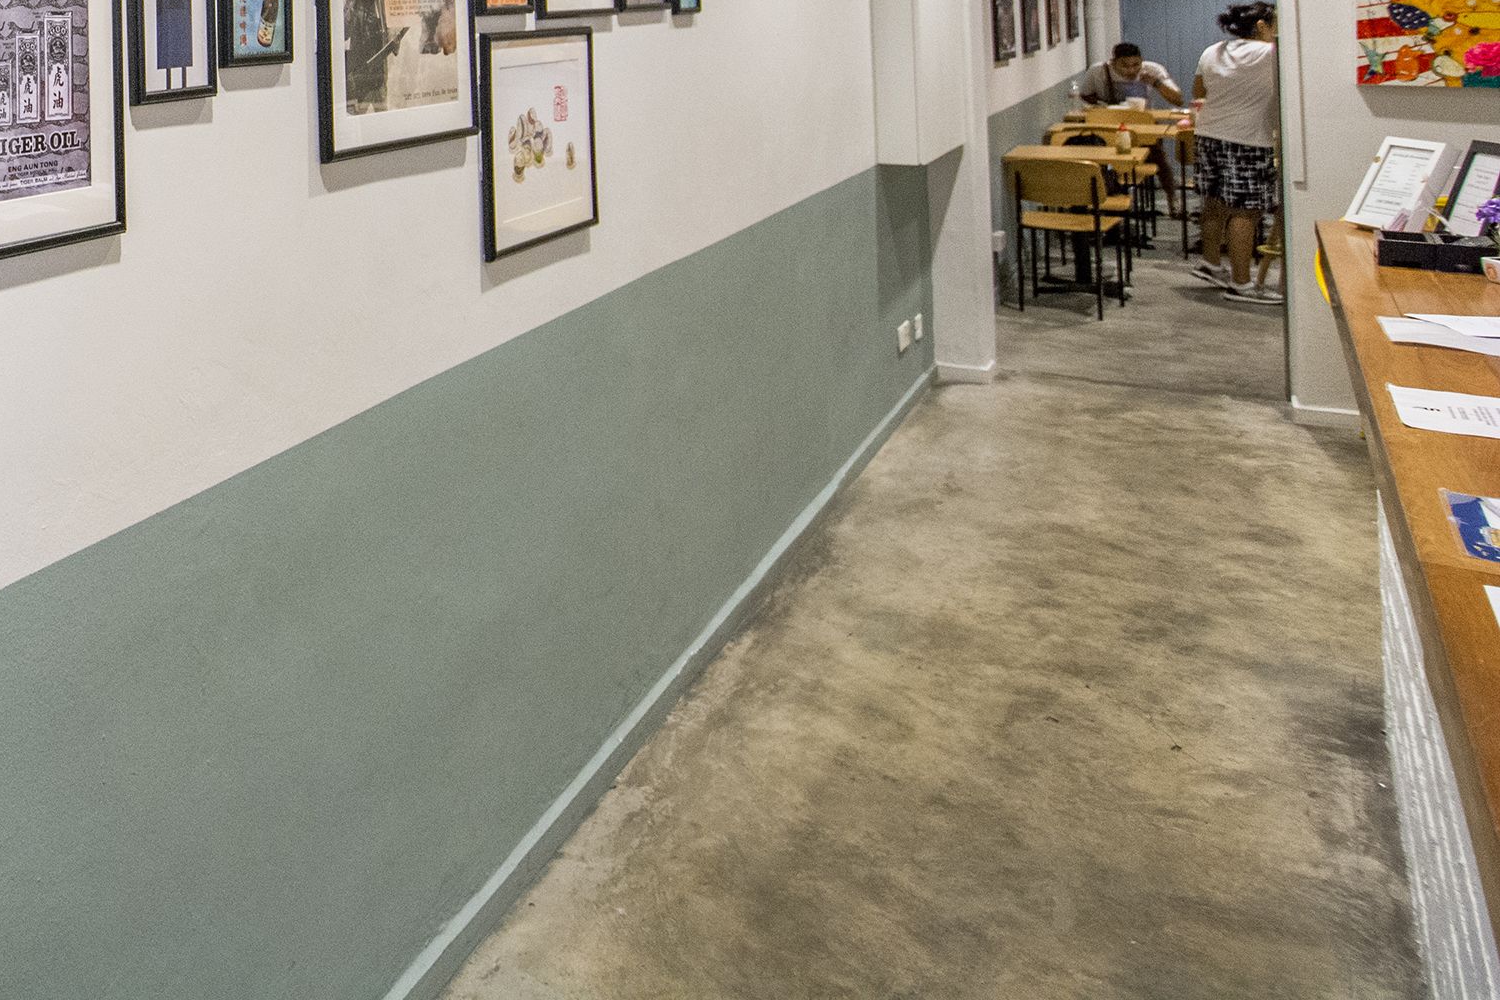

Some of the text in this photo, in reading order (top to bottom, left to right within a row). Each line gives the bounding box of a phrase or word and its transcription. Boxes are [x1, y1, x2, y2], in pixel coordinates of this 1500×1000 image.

[50, 131, 80, 149] OIL
[8, 160, 58, 173] ENG AUN TONG
